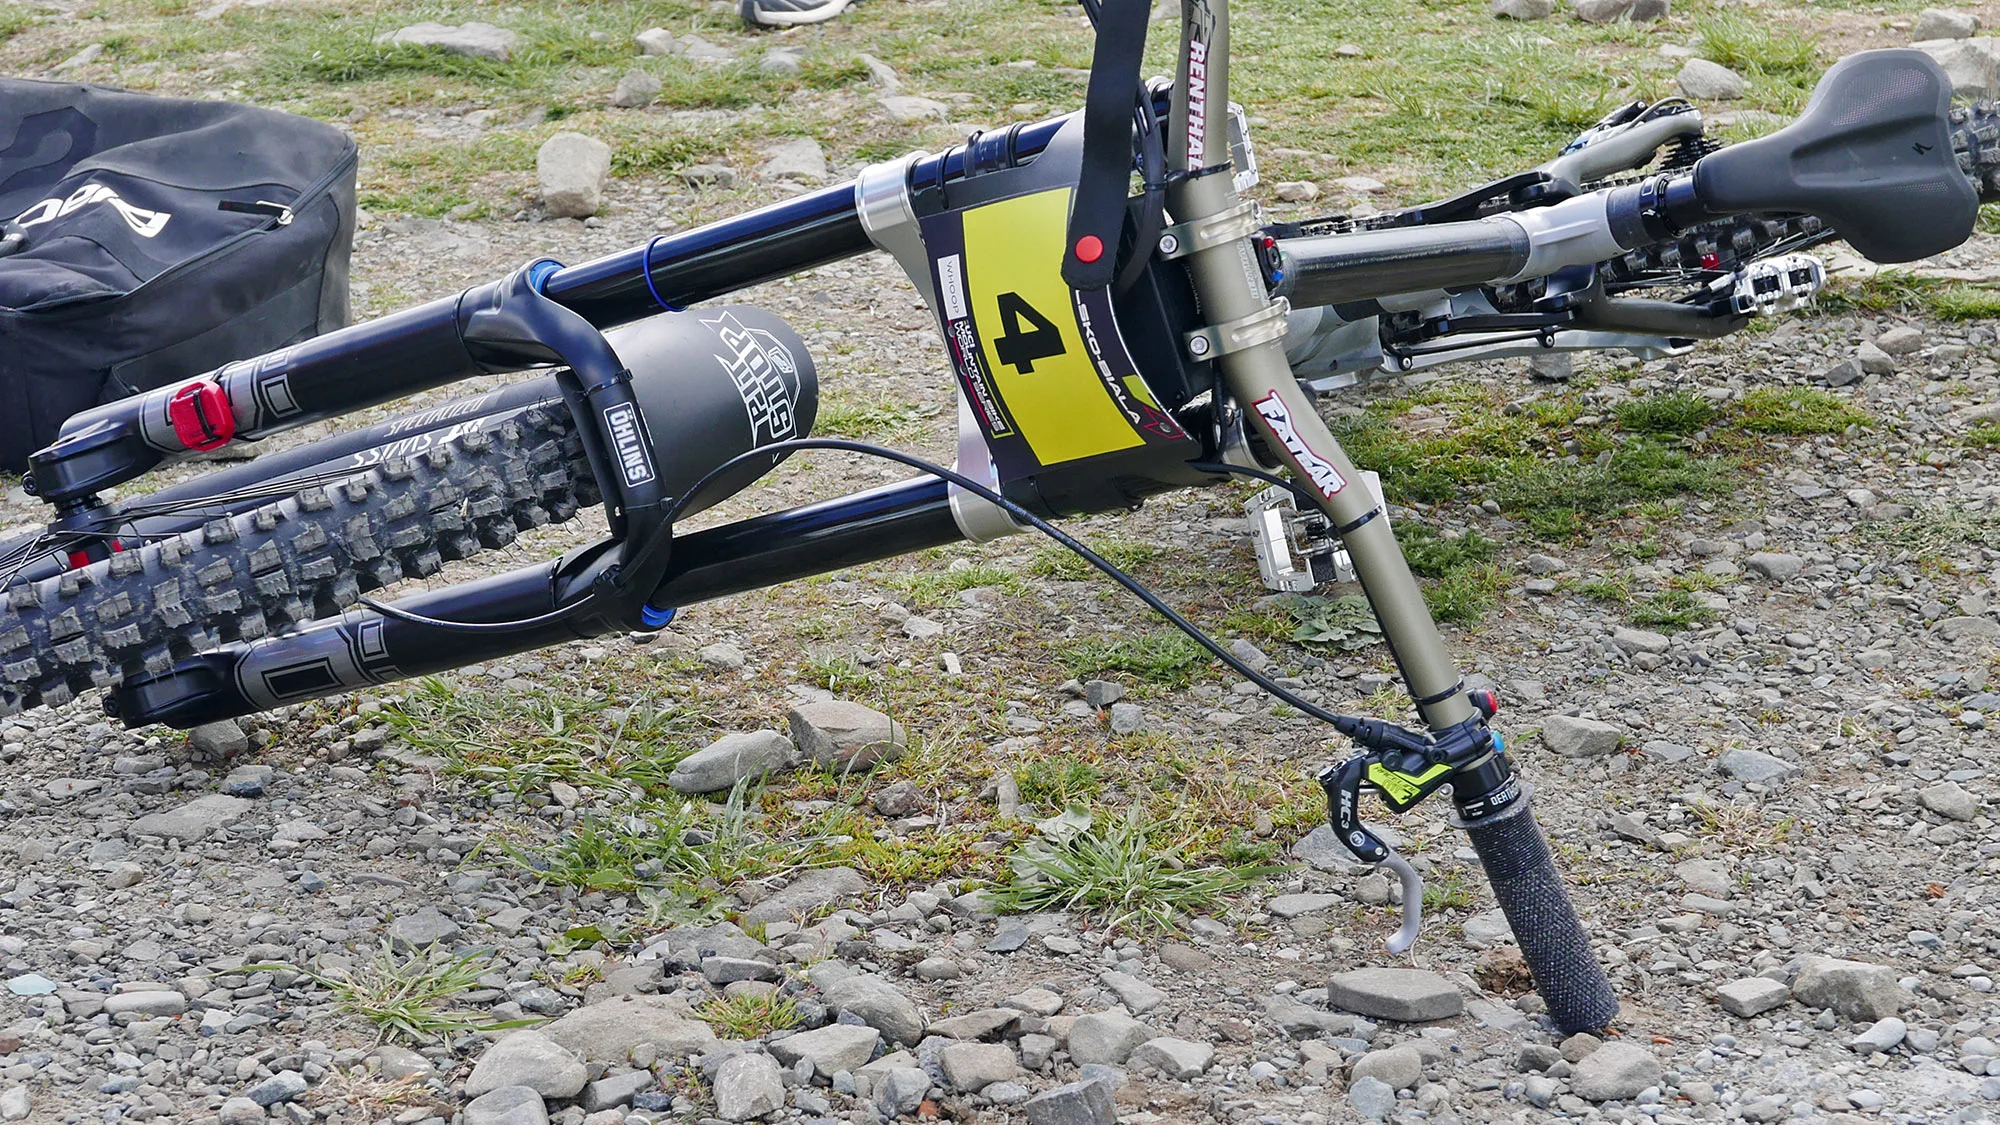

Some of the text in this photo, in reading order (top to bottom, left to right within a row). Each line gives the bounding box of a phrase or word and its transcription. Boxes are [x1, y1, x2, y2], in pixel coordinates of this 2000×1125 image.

[1188, 39, 1206, 172] RENTHAL
[947, 260, 960, 314] WHOOP
[965, 325, 976, 348] UCI
[994, 292, 1067, 375] 4
[954, 322, 1000, 432] WORLD SERIES
[958, 321, 1006, 431] MOUNTAIN BIKE
[384, 395, 489, 438] SPECIALIZED
[610, 409, 648, 481] ÖHLINS
[1340, 789, 1352, 829] HC3
